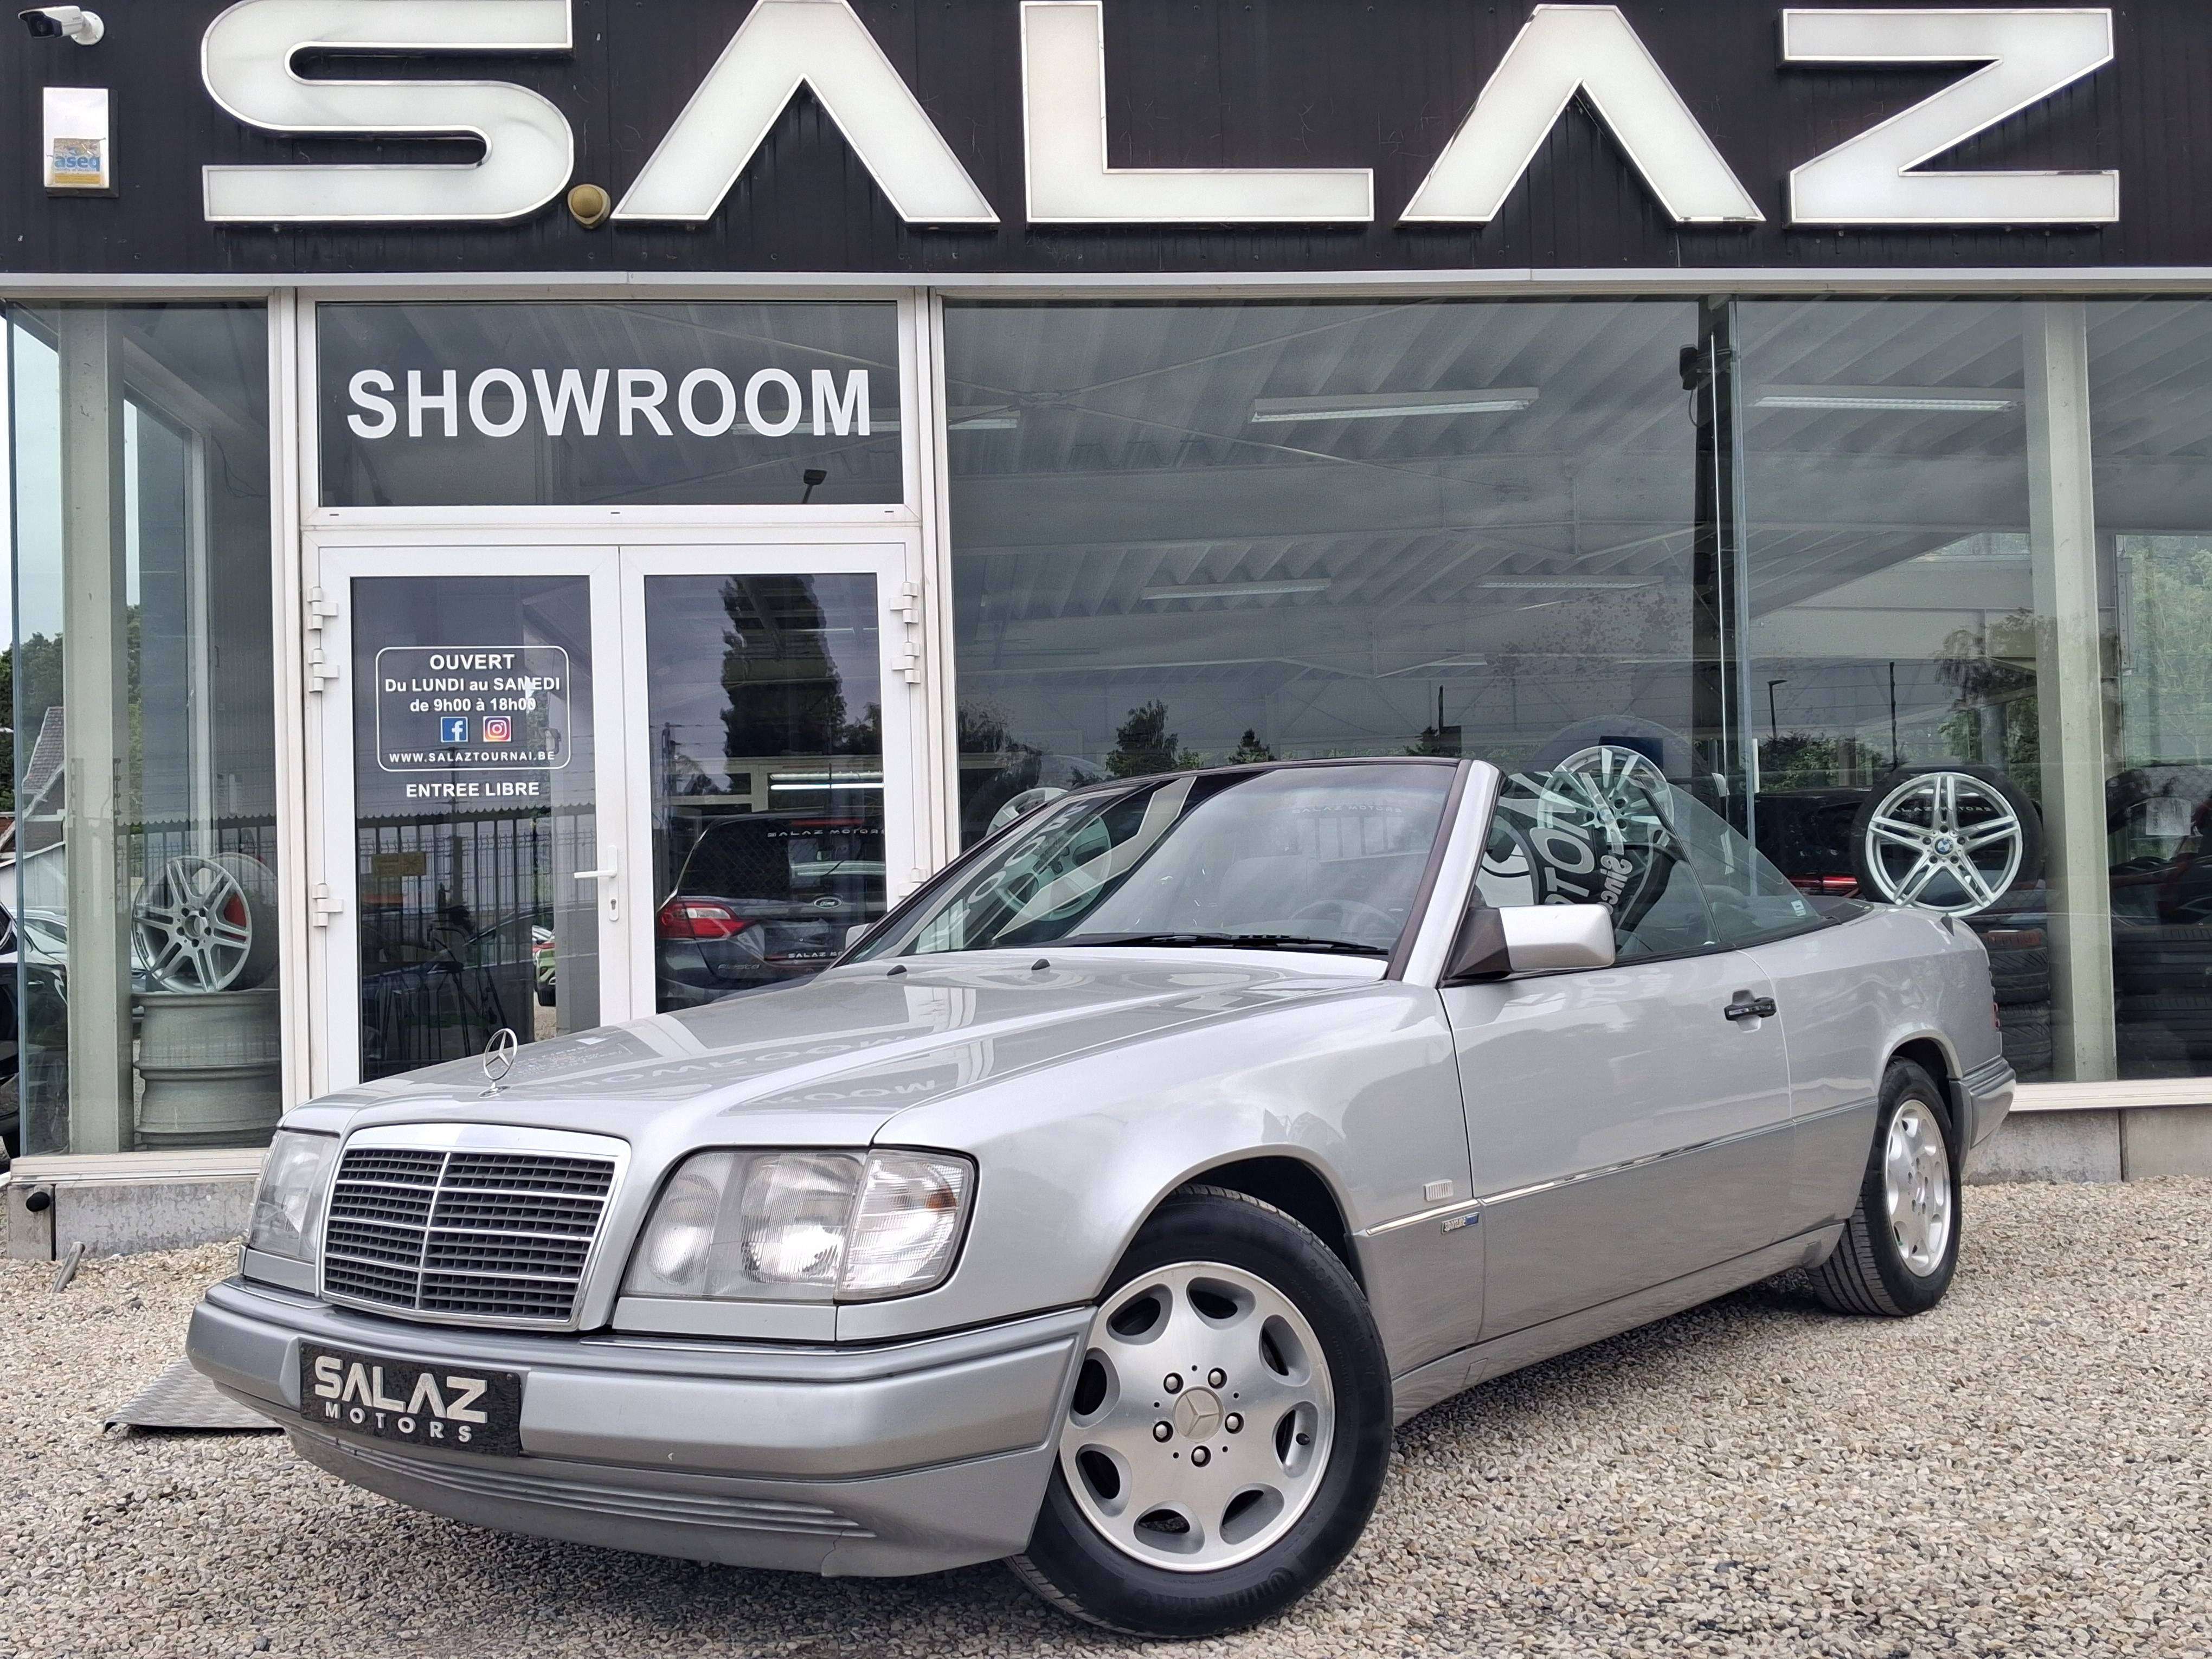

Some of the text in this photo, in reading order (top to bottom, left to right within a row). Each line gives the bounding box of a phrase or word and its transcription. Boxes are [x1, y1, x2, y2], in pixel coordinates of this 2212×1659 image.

[200, 0, 2119, 223] SALAZ
[347, 368, 870, 438] SHOWROOM
[429, 654, 515, 670] OUVERT
[385, 677, 560, 692] Du LUNDI au SAMEDI
[410, 697, 536, 712] de 9h00 à 18h00
[389, 751, 555, 763] WWW.SALAZTOURNAI.BE
[406, 782, 540, 798] ENTREE LIBRE
[767, 829, 824, 838] SALAZ
[314, 1355, 488, 1424] SALAZ
[325, 1401, 472, 1443] MOTORS
